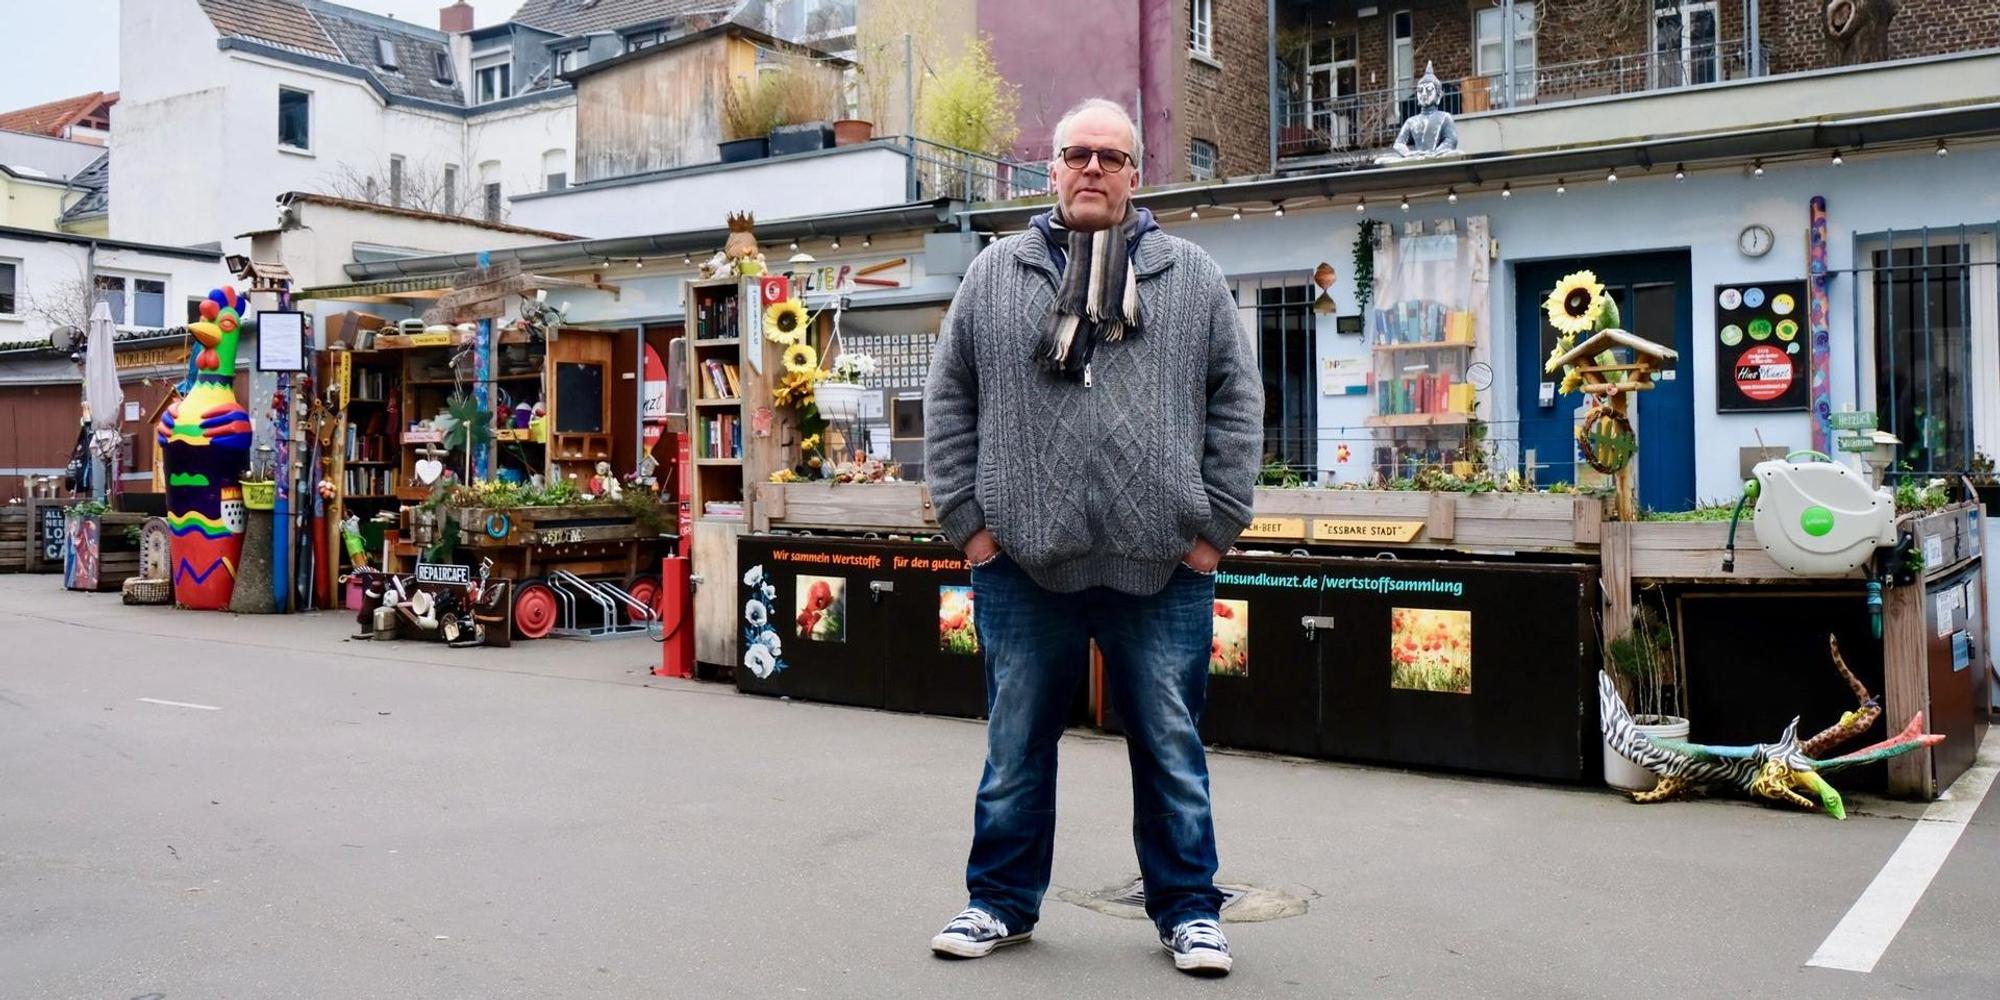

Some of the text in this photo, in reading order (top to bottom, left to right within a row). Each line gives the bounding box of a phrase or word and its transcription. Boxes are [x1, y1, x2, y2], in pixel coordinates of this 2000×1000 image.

[45, 511, 63, 519] ALL
[45, 528, 64, 539] LO
[773, 550, 788, 560] Wir
[791, 553, 829, 563] sammeln
[832, 554, 880, 568] Wertstoffe
[893, 556, 908, 569] für
[911, 558, 929, 568] den
[932, 559, 961, 570] guten
[419, 566, 467, 582] REPAIRCAFE
[1321, 574, 1463, 596] /wertstoffsammlung
